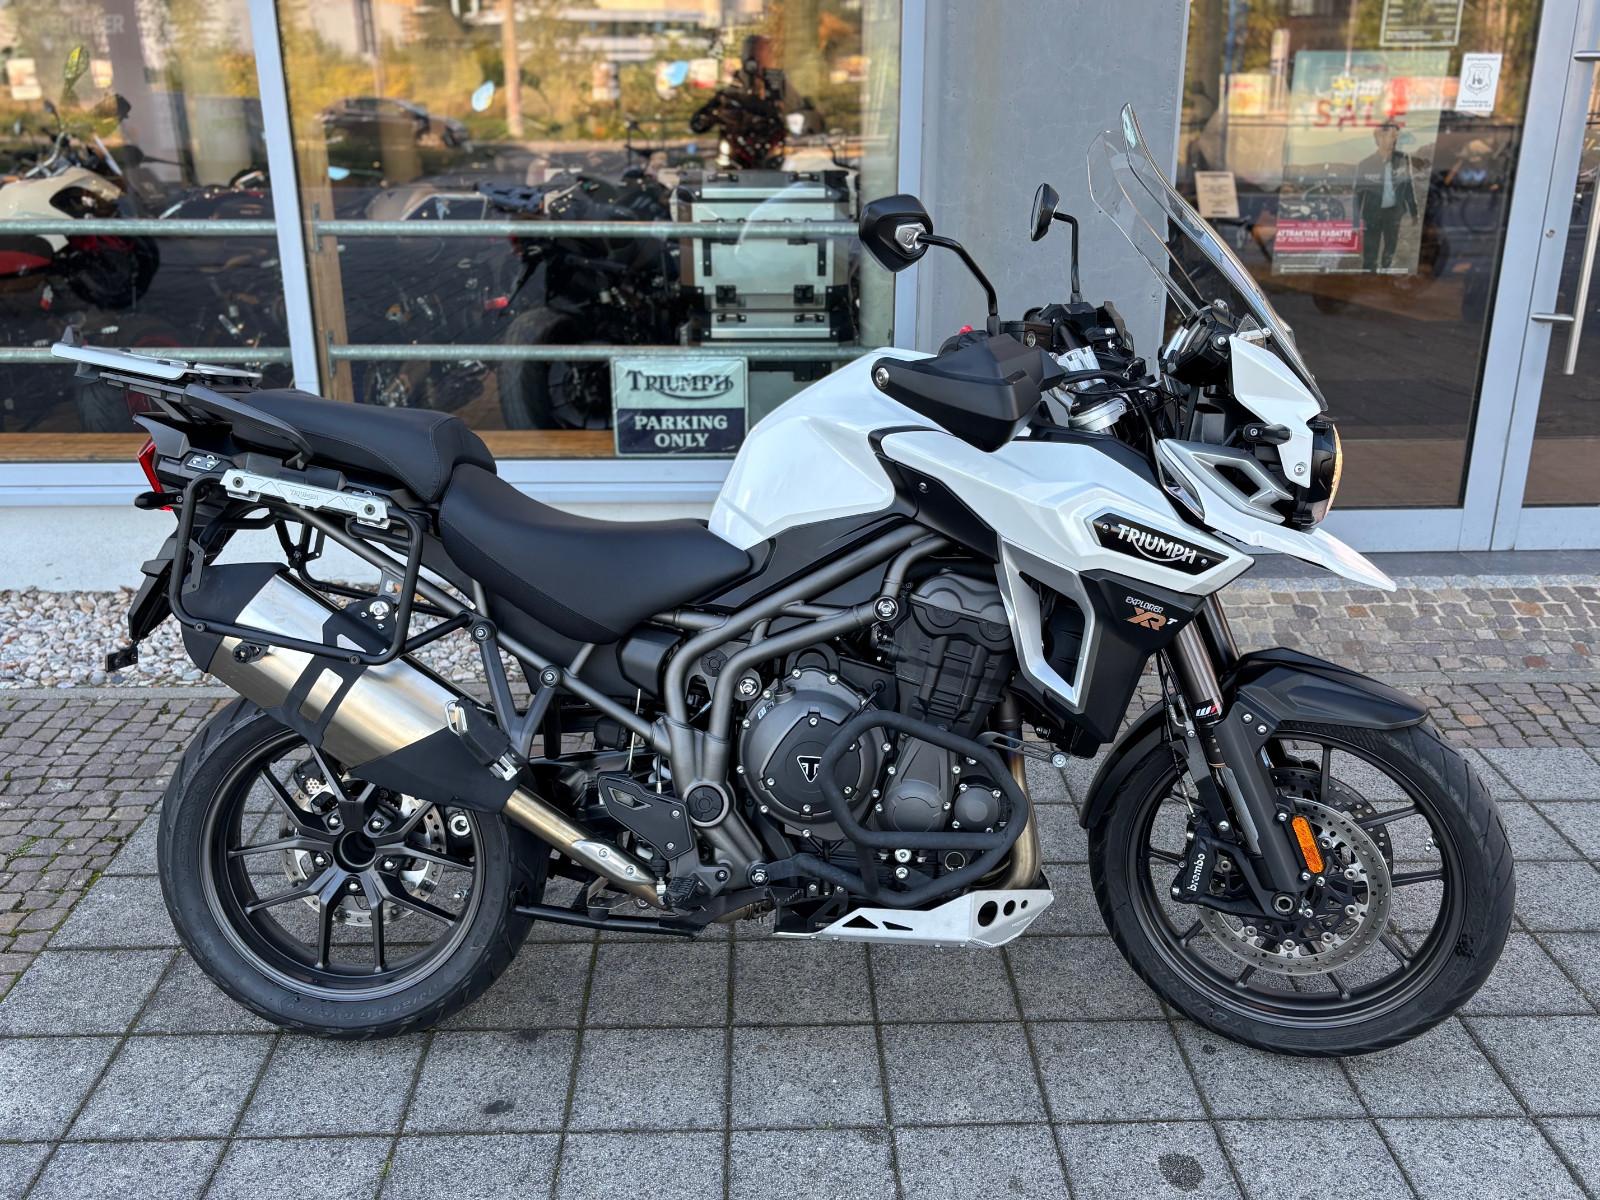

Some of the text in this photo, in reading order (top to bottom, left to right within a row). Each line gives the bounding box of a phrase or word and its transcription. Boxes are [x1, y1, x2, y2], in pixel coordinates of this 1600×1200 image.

[1313, 99, 1406, 127] SALE
[626, 369, 734, 400] TRIUMPH
[634, 415, 728, 430] PARKING
[654, 432, 709, 447] ONLY
[1117, 523, 1197, 564] TRIUMPH
[1125, 596, 1164, 613] EXPLORER
[1187, 853, 1206, 892] brembo
